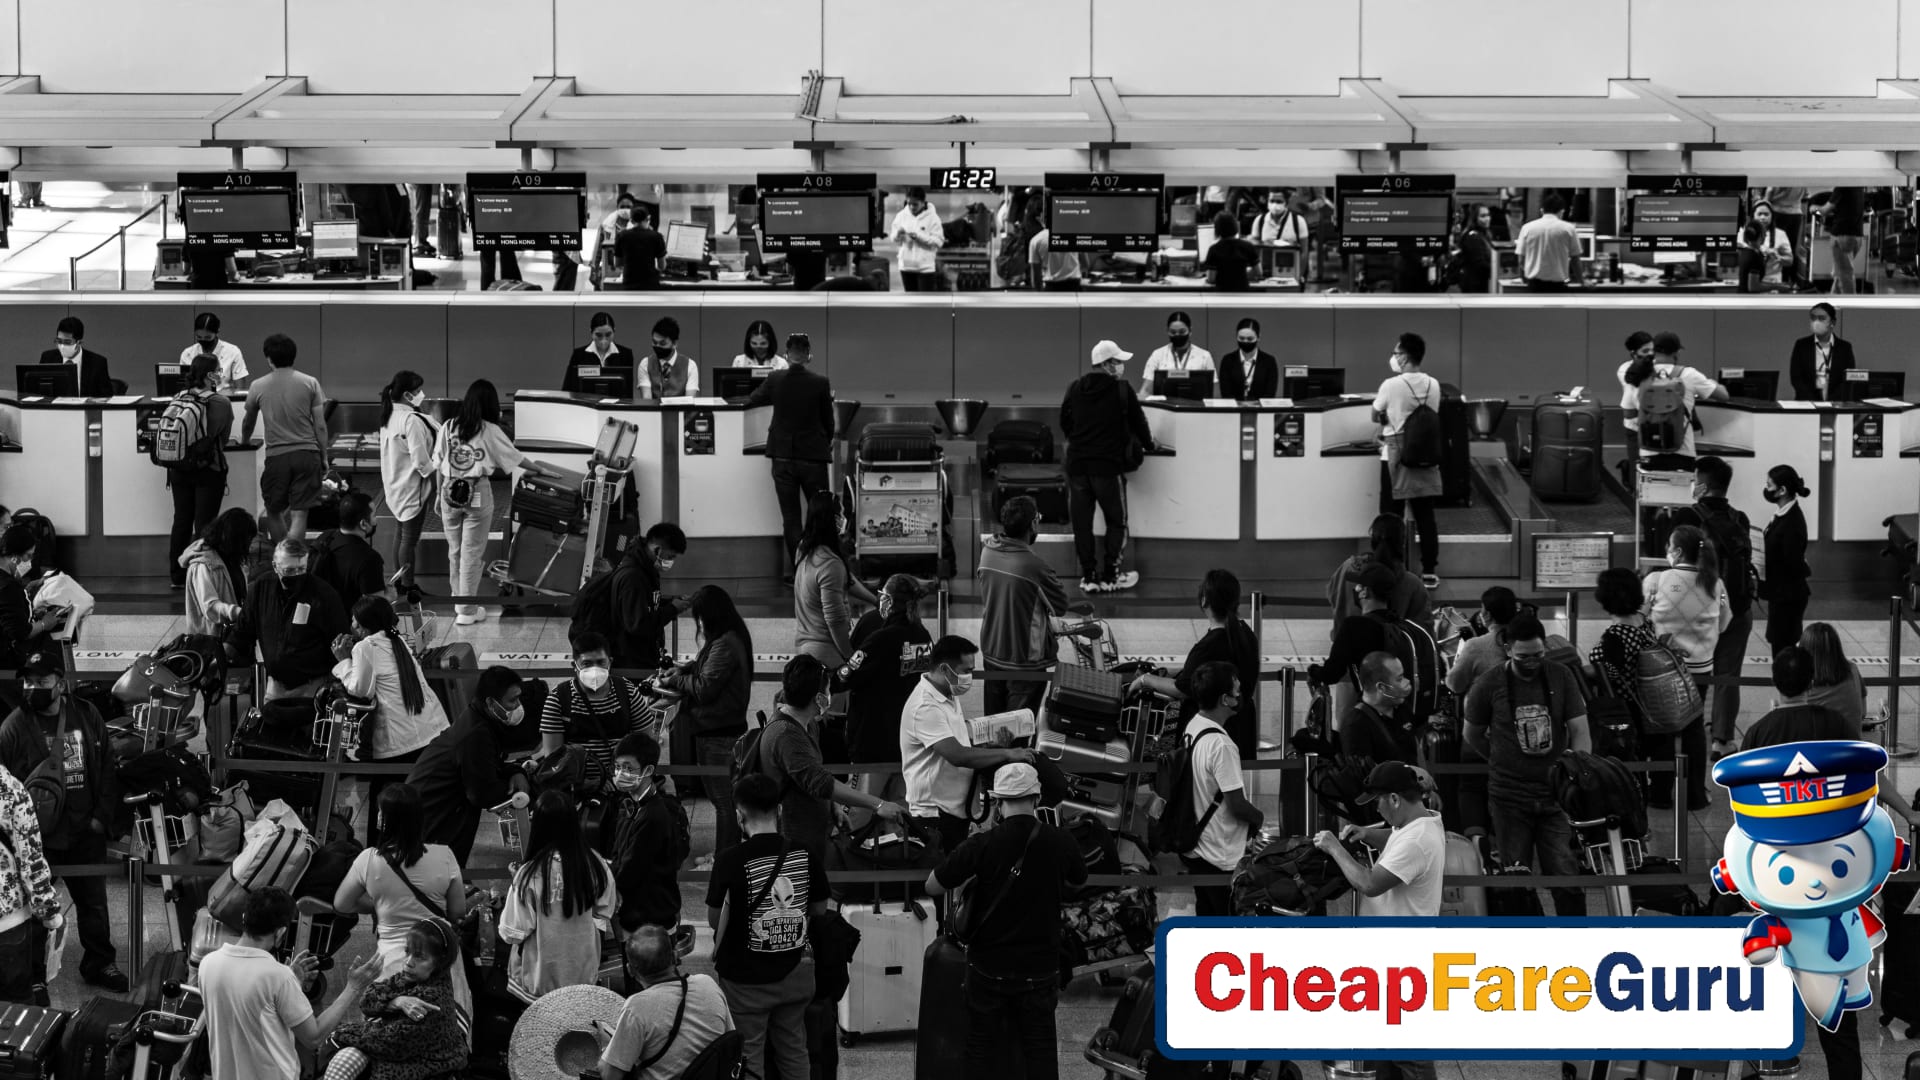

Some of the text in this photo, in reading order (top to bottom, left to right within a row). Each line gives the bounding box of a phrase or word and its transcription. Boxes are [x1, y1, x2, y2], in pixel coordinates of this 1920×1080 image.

[225, 175, 251, 185] A 10
[512, 176, 541, 185] A 09
[803, 176, 832, 187] A 08
[942, 170, 994, 188] 15:22
[1091, 176, 1119, 186] A 07
[1382, 177, 1411, 188] A 06
[1673, 178, 1702, 188] A 05
[783, 923, 799, 933] SAFE
